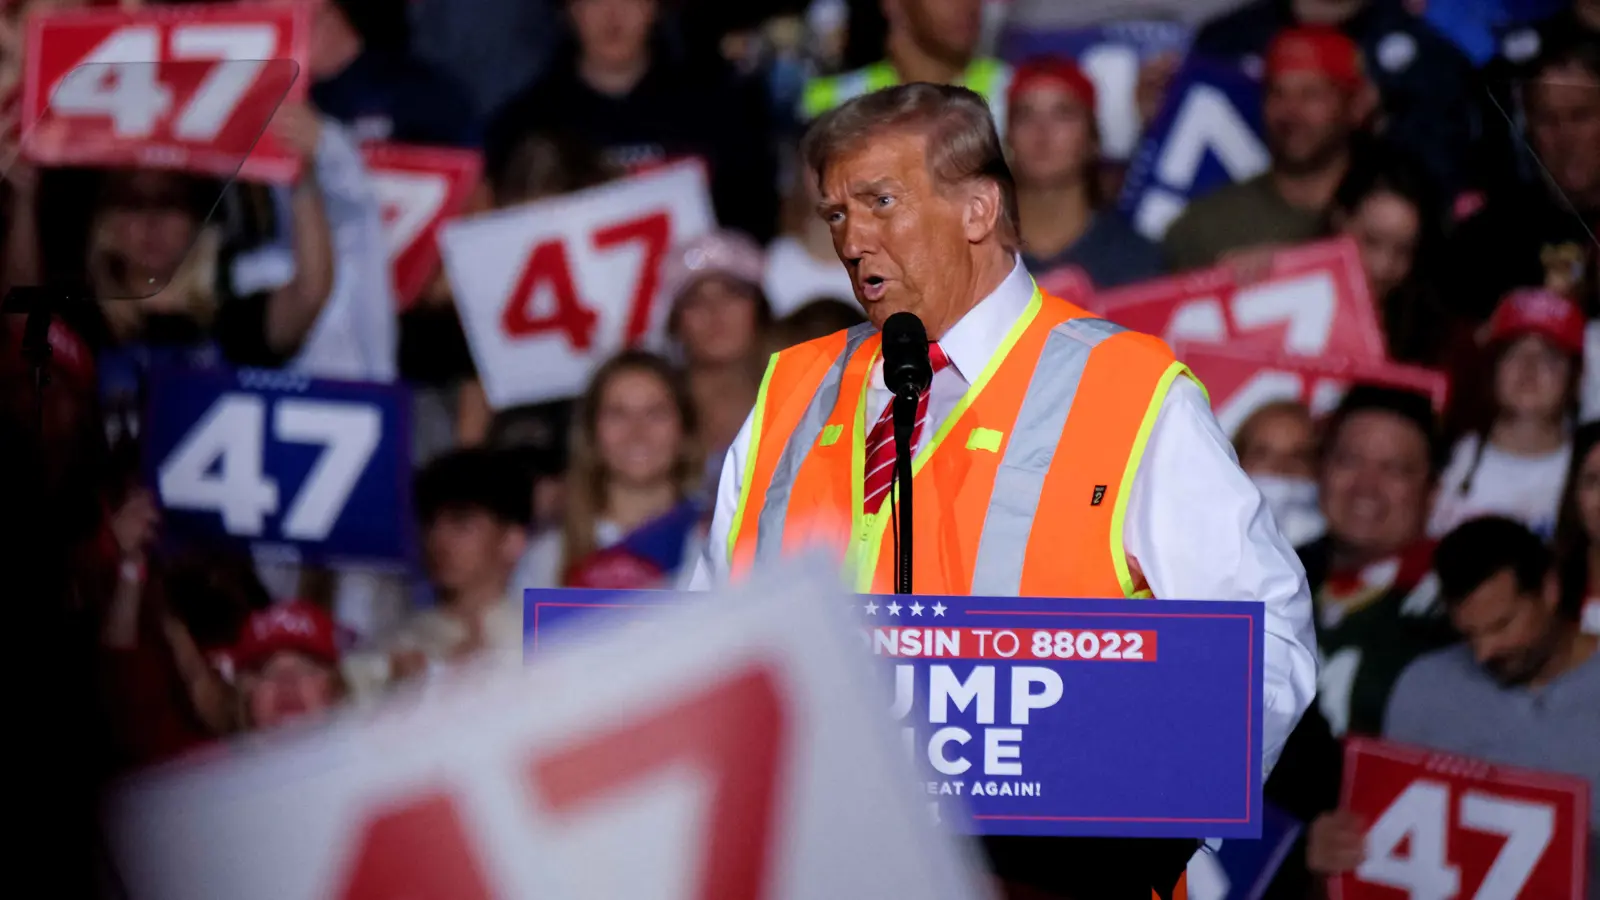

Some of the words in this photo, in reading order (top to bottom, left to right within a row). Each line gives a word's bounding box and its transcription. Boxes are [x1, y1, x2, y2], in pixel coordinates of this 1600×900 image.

[49, 23, 278, 141] 47
[500, 210, 670, 355] 47
[157, 393, 383, 542] 47
[864, 628, 961, 657] NSIN
[971, 629, 1020, 658] TO
[1030, 631, 1144, 660] 88022
[888, 664, 1064, 725] UMP
[920, 781, 965, 796] EAT
[970, 781, 1042, 797] AGAIN!
[1355, 778, 1557, 900] 47
